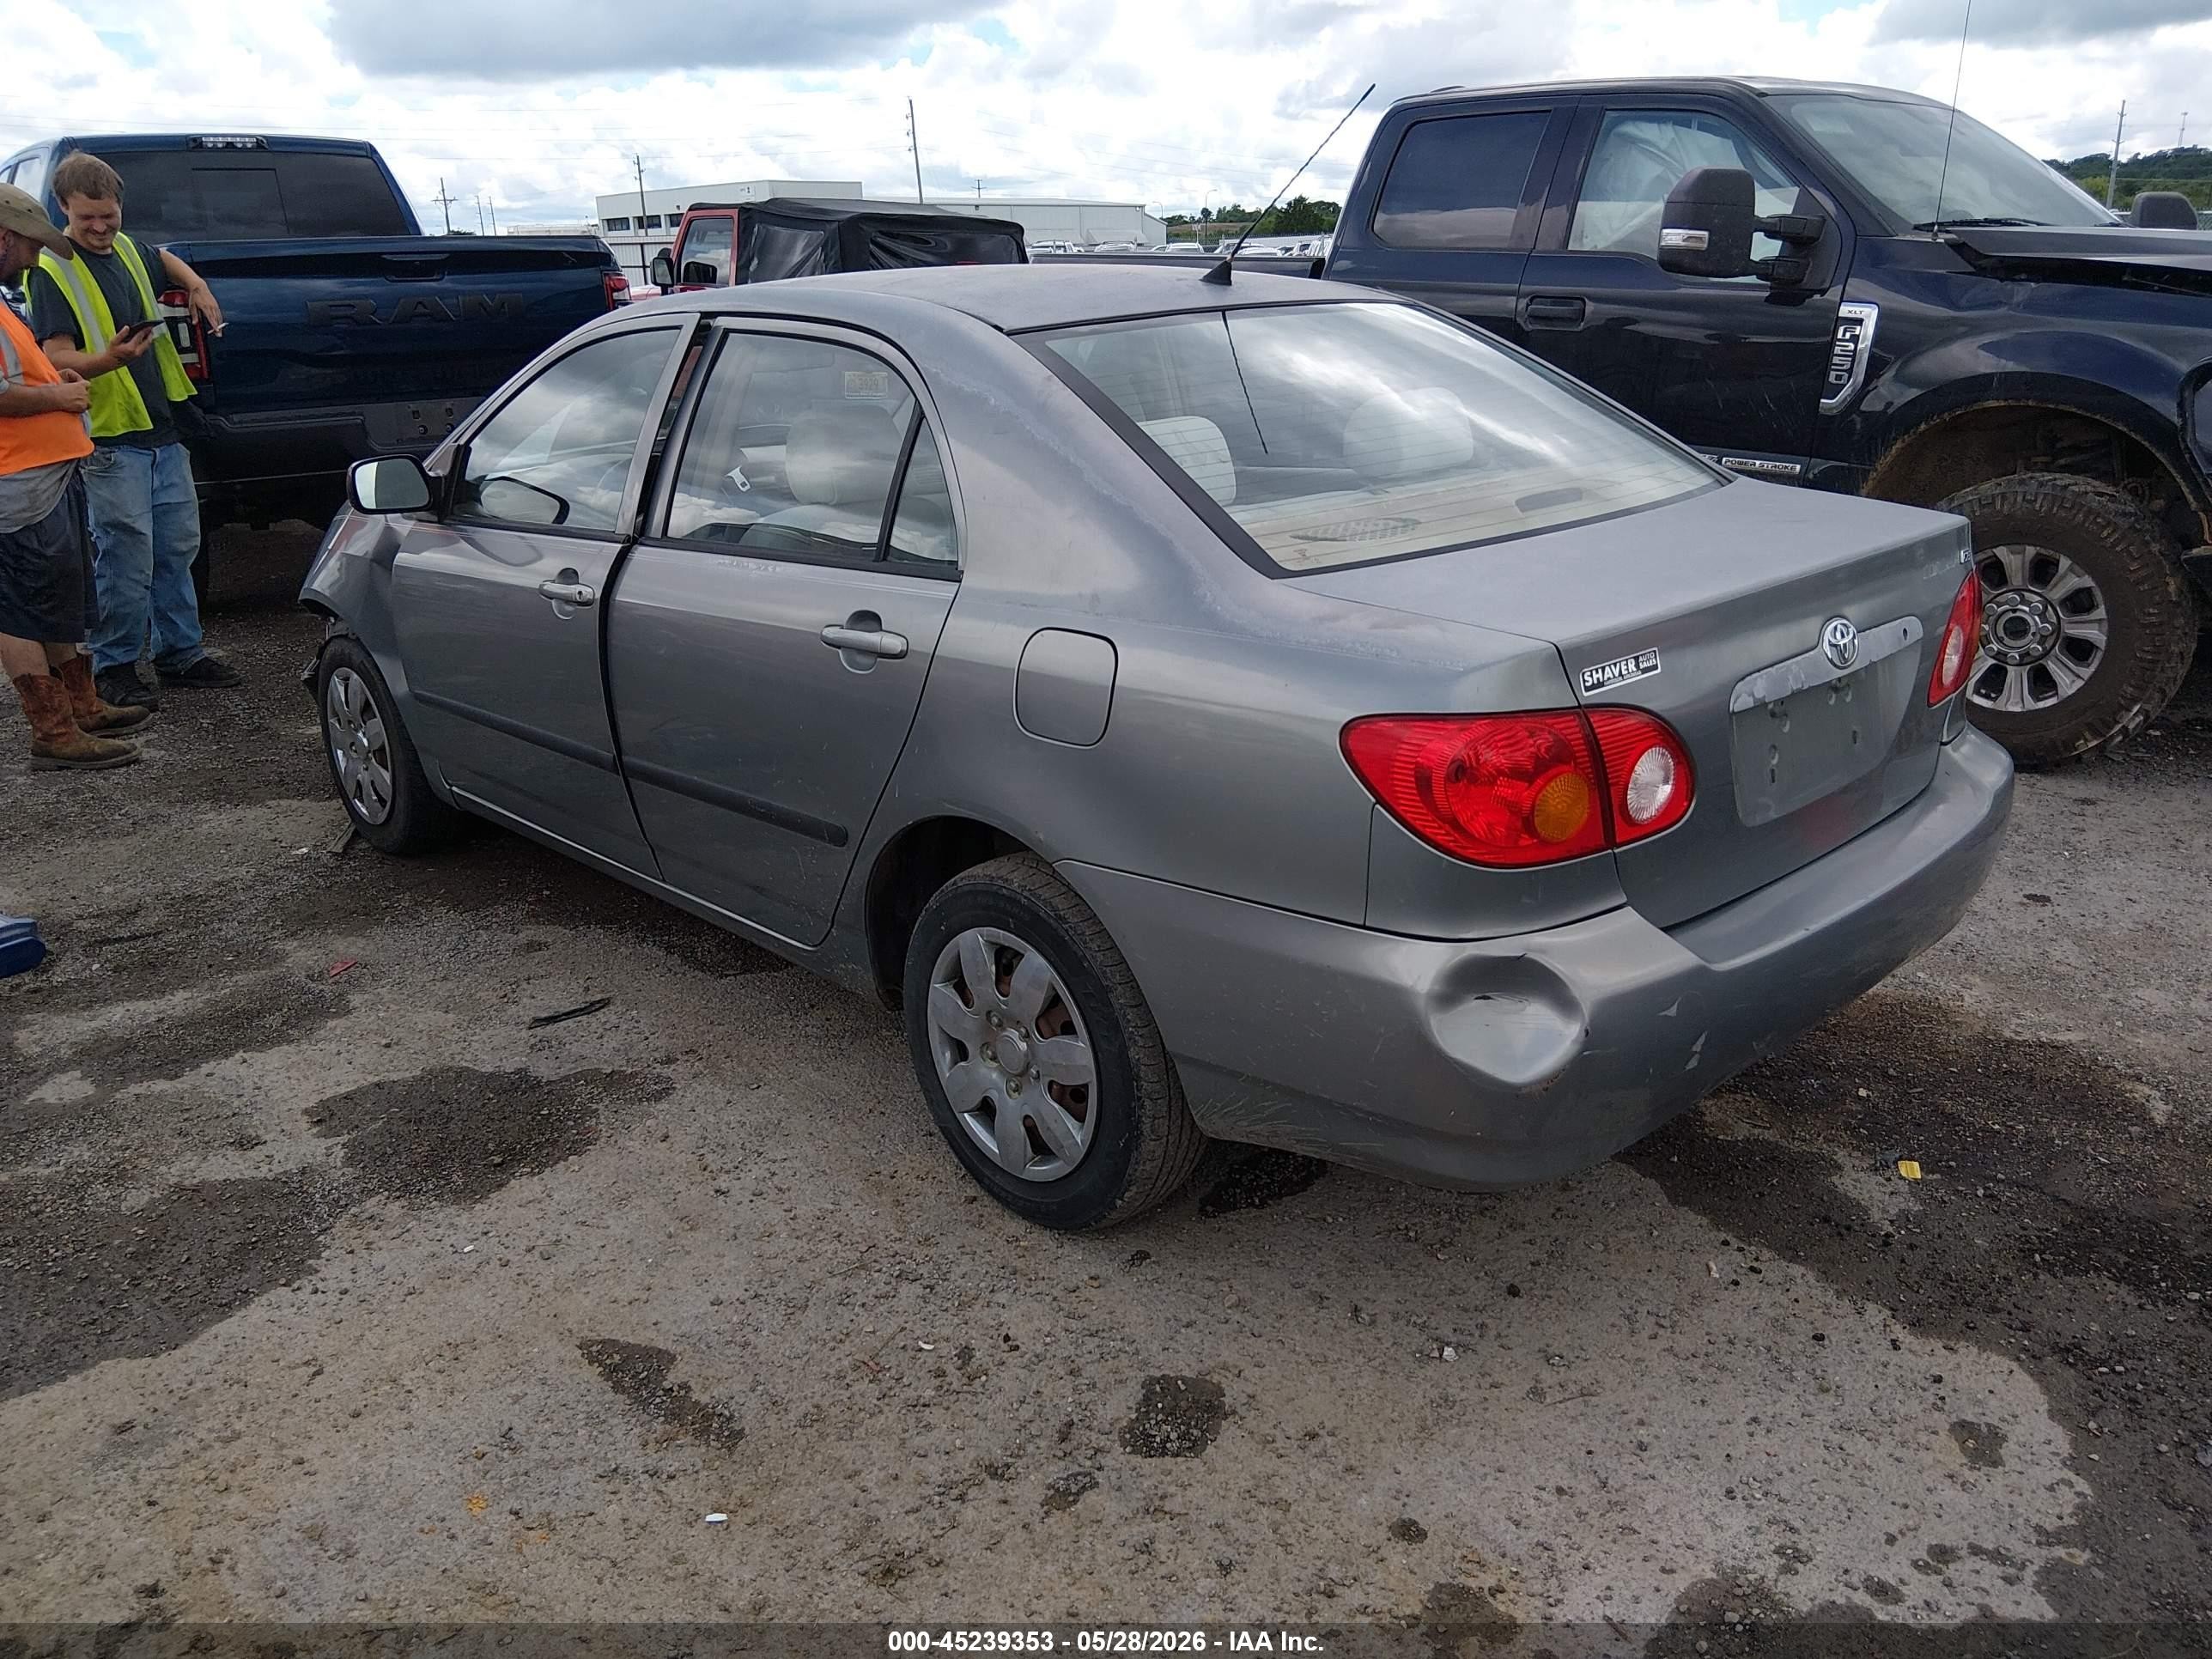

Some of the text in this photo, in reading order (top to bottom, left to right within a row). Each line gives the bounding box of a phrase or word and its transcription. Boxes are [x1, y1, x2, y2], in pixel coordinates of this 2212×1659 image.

[305, 294, 523, 325] RAM
[1724, 459, 1757, 467] POWER
[1759, 462, 1798, 471] STROKE
[1638, 652, 1655, 663] AUTO
[1639, 658, 1656, 670] SALES
[1583, 659, 1637, 687] SHAVER
